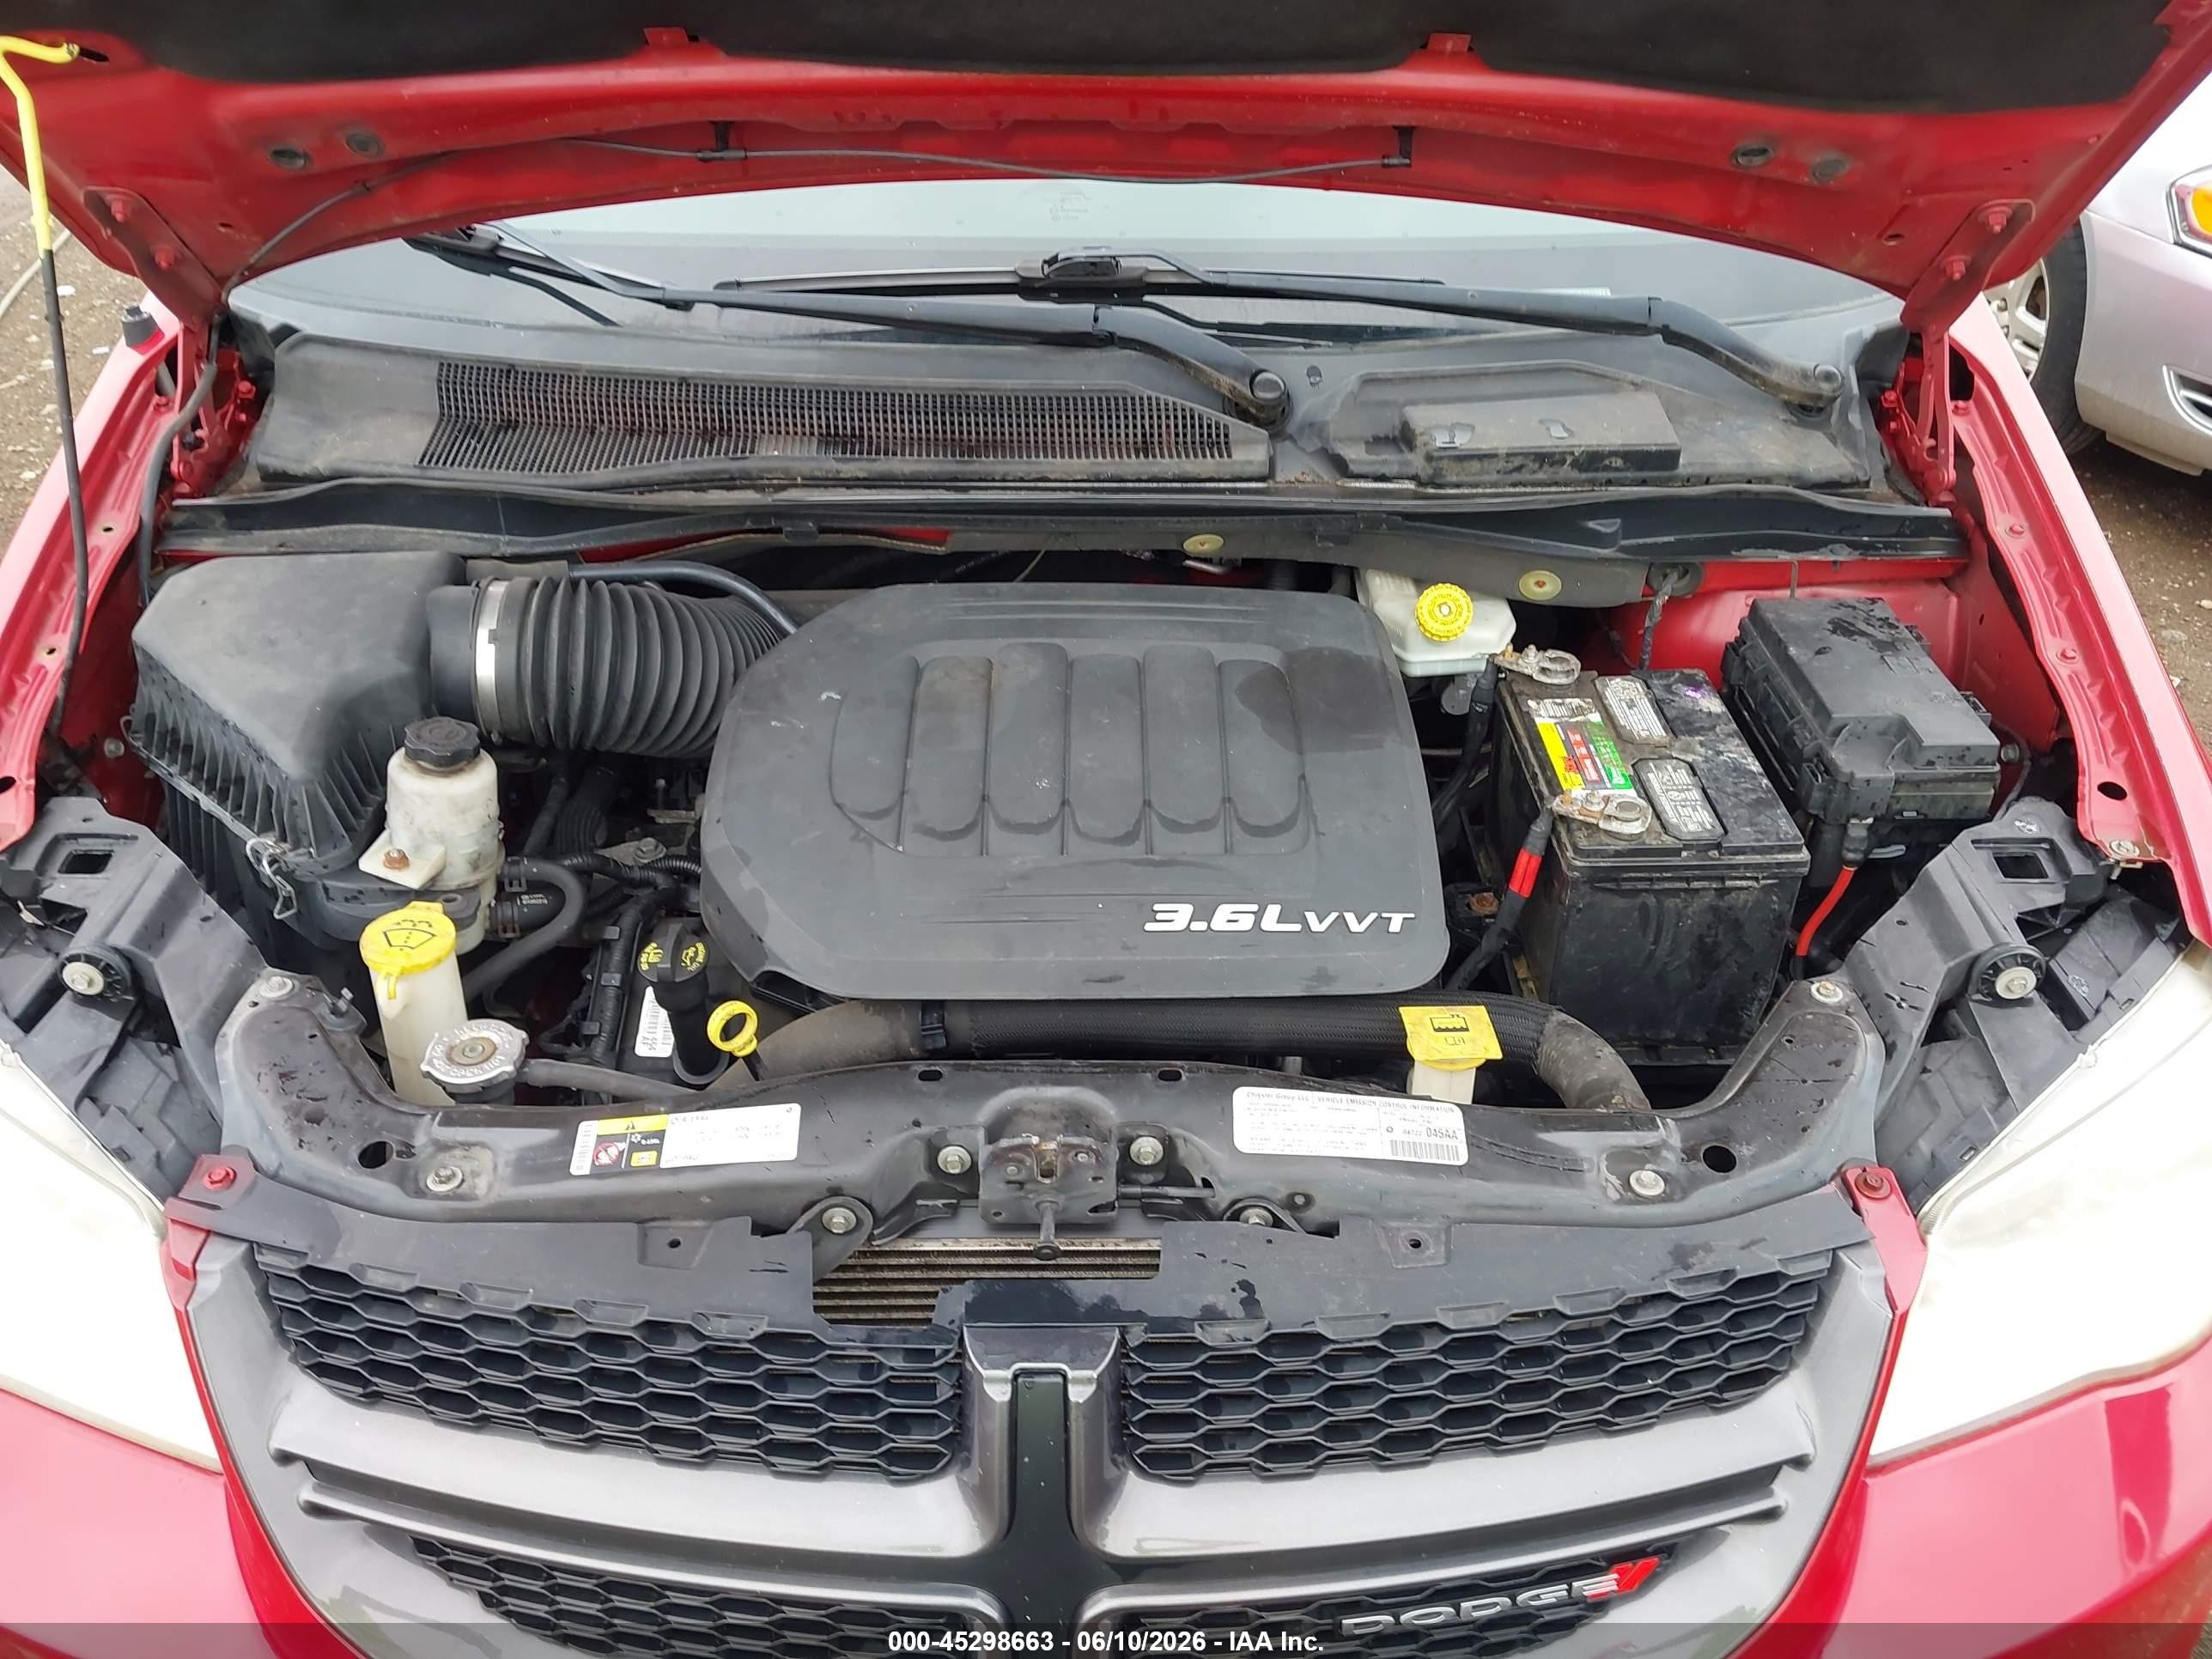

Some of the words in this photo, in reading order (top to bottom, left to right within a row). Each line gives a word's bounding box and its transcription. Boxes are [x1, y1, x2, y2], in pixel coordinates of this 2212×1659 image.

[1346, 1097, 1376, 1107] EMISSION
[1378, 1100, 1407, 1109] CONTROL
[1409, 1103, 1455, 1114] INFORMATION
[1340, 1572, 1619, 1637] DODGE
